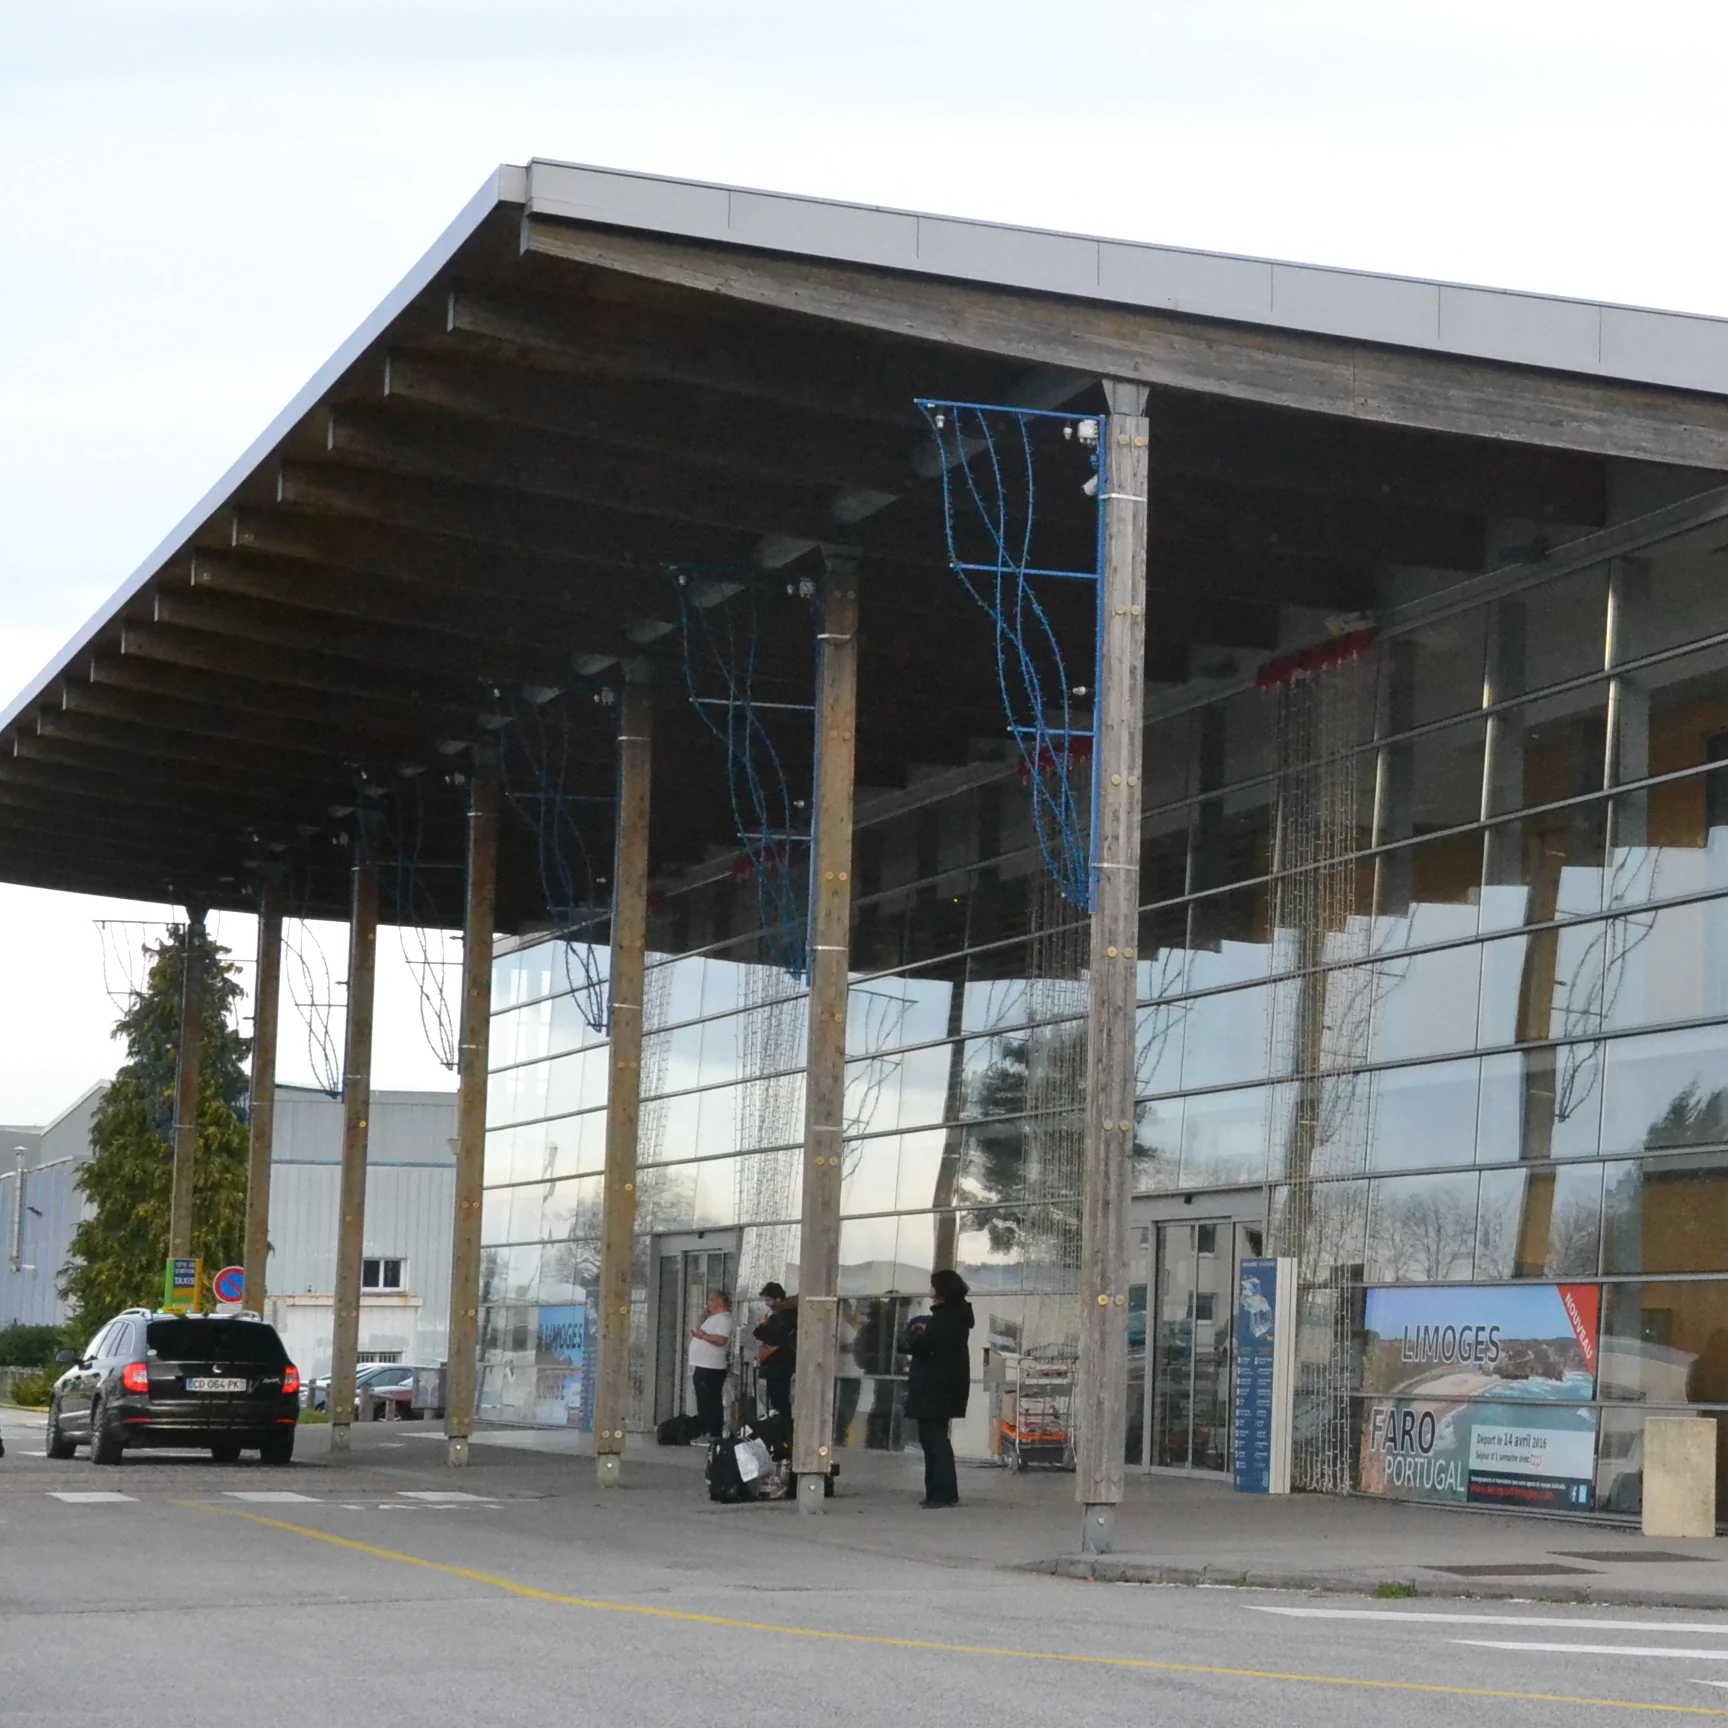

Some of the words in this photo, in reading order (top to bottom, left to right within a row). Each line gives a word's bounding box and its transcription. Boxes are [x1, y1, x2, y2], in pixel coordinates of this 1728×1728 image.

[174, 1276, 195, 1285] TAXIS
[1401, 1324, 1500, 1363] LIMOGES
[1564, 1292, 1593, 1360] NOUVEAU
[1370, 1406, 1437, 1455] FARO
[1497, 1435, 1503, 1446] le
[1504, 1432, 1513, 1447] 14
[1515, 1434, 1531, 1449] avril
[1532, 1437, 1548, 1450] 2016
[1385, 1456, 1465, 1492] PORTUGAL
